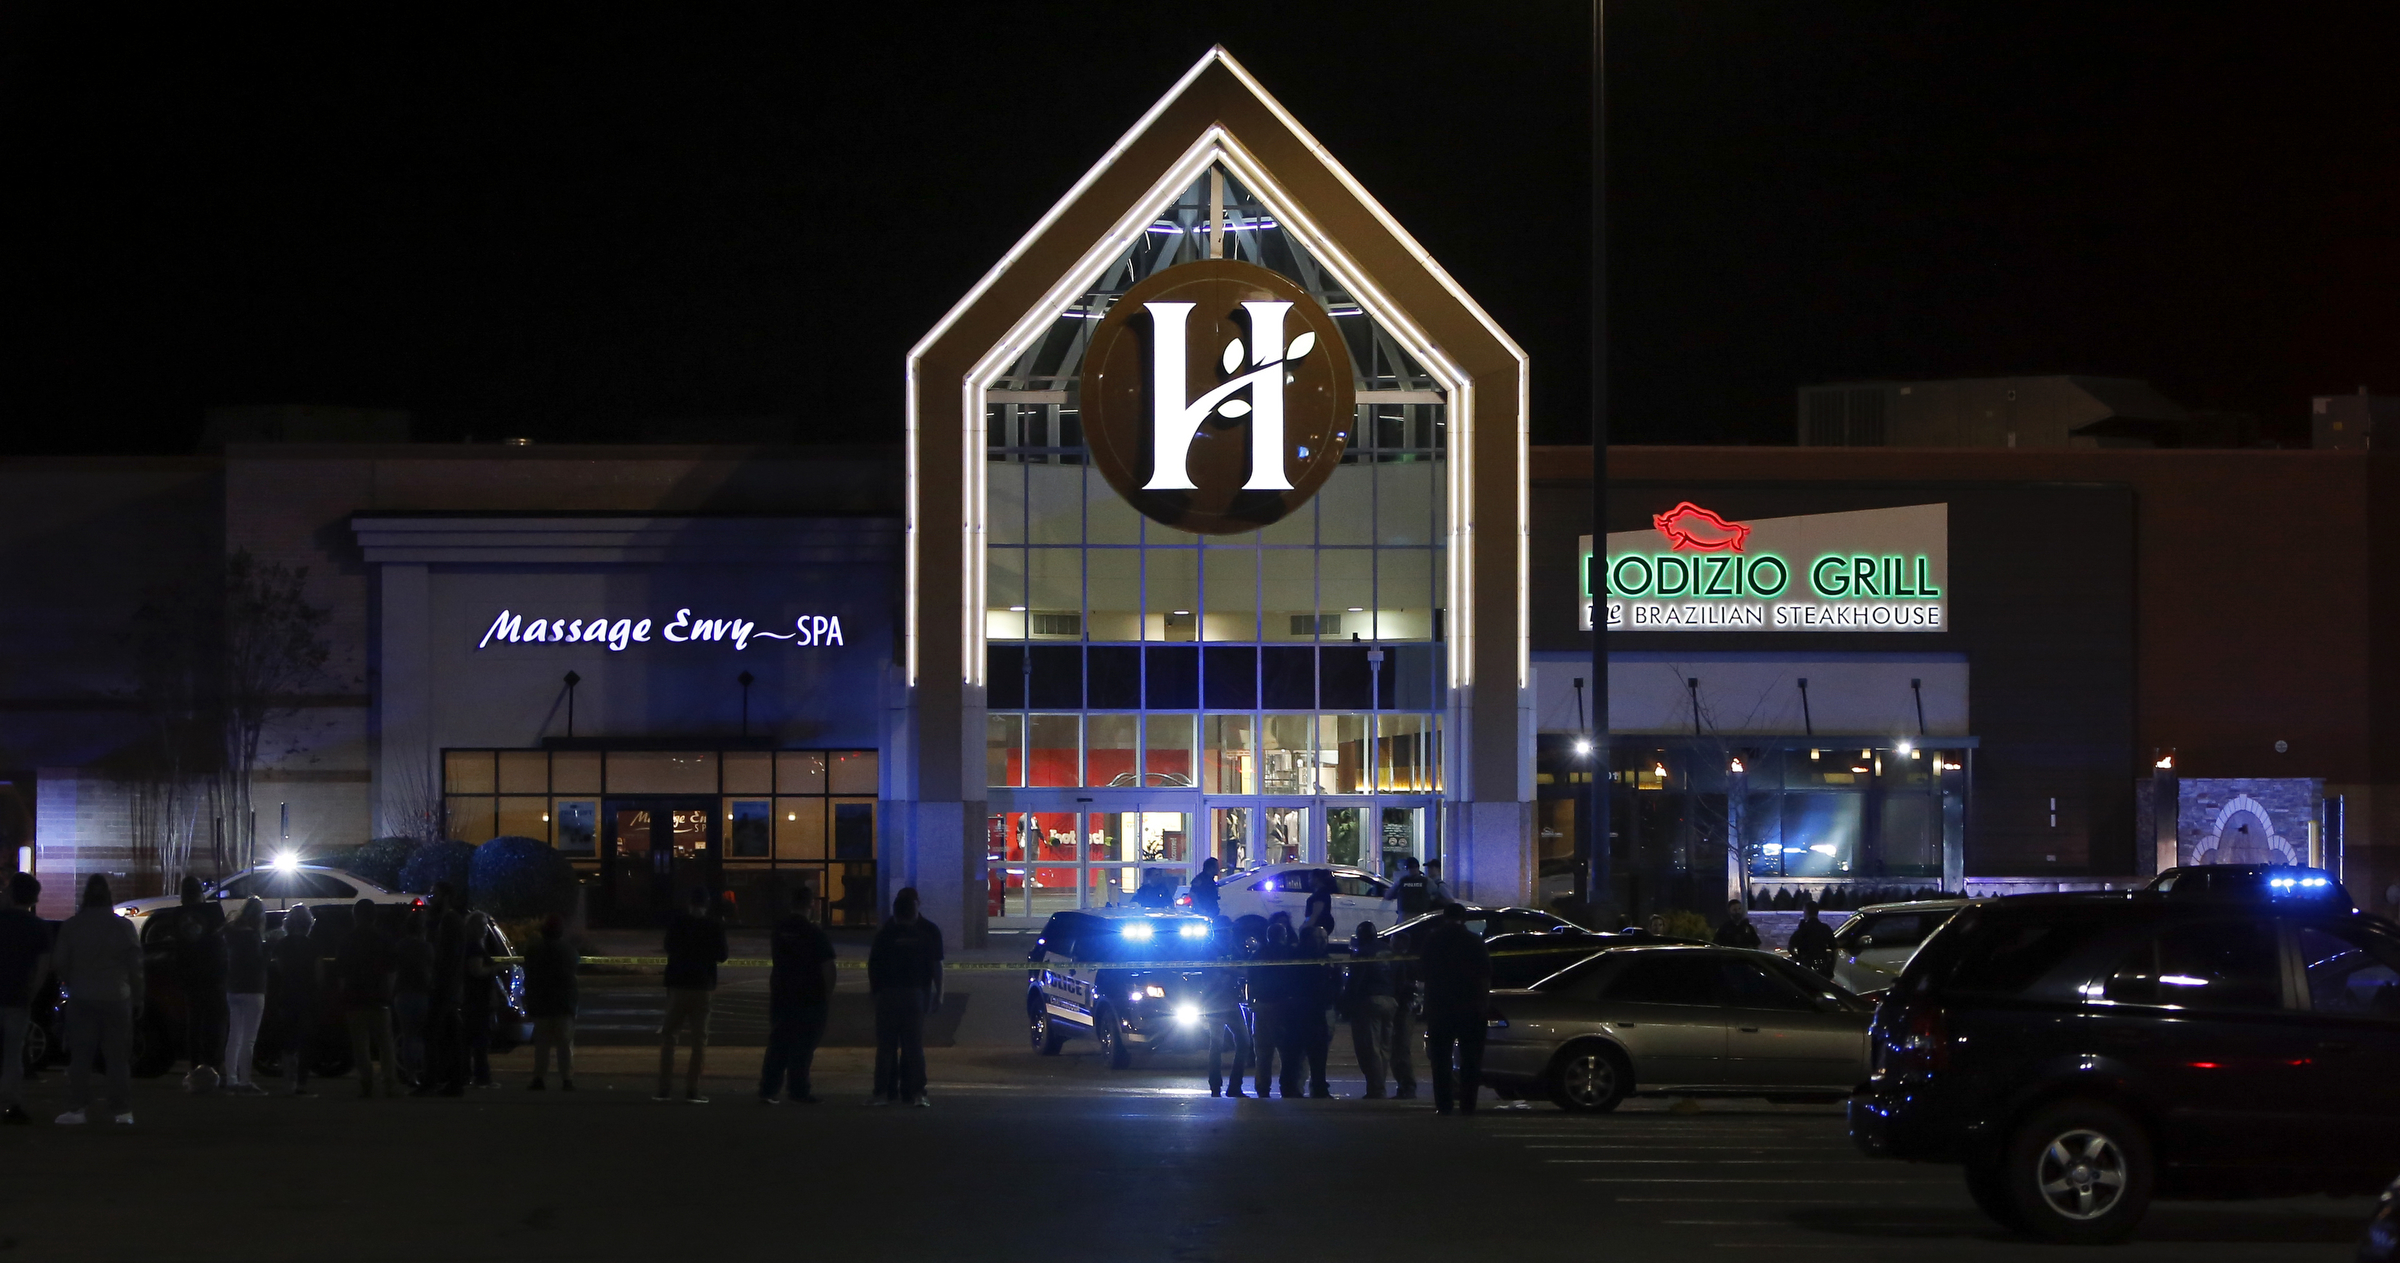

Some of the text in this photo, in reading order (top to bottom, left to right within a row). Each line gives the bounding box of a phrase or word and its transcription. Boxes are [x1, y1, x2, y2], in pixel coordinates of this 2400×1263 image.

[1812, 556, 1939, 596] GRILL
[479, 608, 844, 651] Massage Envy SPA
[1636, 606, 1762, 625] BRAZILIAN
[1776, 606, 1939, 625] STEAKHOUSE
